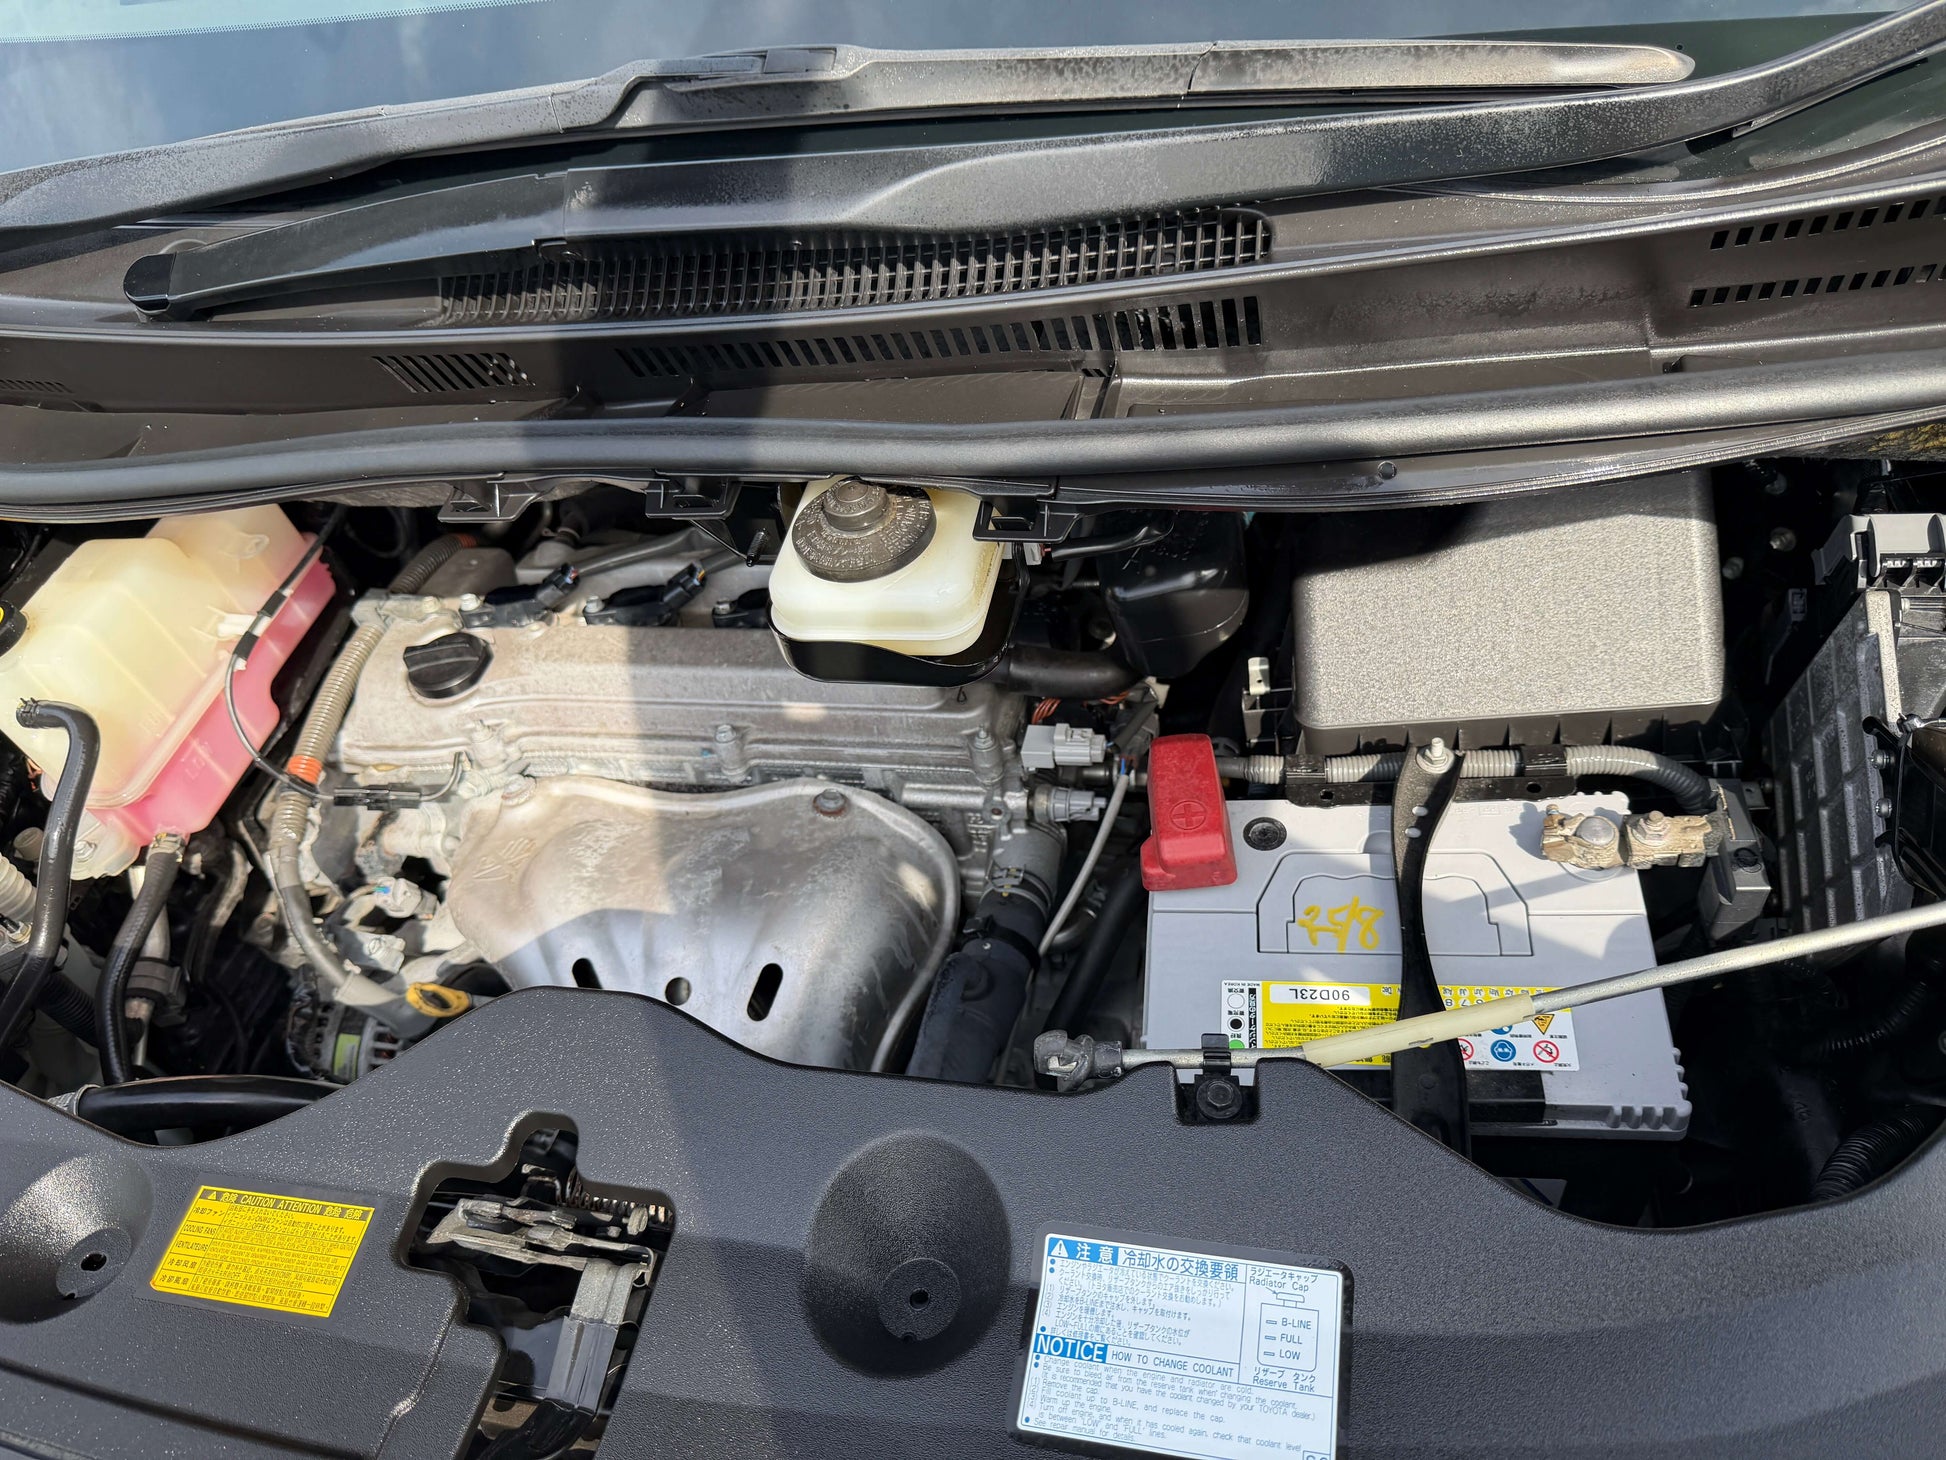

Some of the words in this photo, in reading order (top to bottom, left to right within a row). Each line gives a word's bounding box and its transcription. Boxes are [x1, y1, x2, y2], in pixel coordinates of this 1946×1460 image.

[1289, 988, 1350, 1001] 90D23L
[239, 1195, 275, 1207] CAUTION
[276, 1200, 322, 1214] ATTENTION
[183, 1224, 204, 1233] COOLING
[203, 1227, 216, 1235] FANS
[1122, 1249, 1239, 1281] 冷却水の交換要領
[1250, 1266, 1318, 1283] ラジエータキャップ
[1249, 1275, 1286, 1288] Radiator
[1291, 1281, 1309, 1293] Cap
[1281, 1317, 1311, 1330] B-LINE
[1280, 1333, 1302, 1344] FULL
[1036, 1334, 1104, 1362] NOTICE
[1279, 1349, 1300, 1360] LOW
[1111, 1350, 1131, 1361] HOW
[1136, 1354, 1148, 1364] TO
[1153, 1357, 1188, 1370] CHANGE
[1192, 1362, 1233, 1377] COOLANT
[1074, 1361, 1099, 1371] coolant
[1104, 1365, 1121, 1374] when
[1142, 1371, 1165, 1382] engine
[1170, 1375, 1183, 1384] and
[1188, 1378, 1215, 1388] radiator
[1293, 1372, 1316, 1383] タンク
[1042, 1378, 1067, 1389] Remove
[1071, 1383, 1082, 1391] the
[1084, 1370, 1101, 1379] bleed
[1150, 1381, 1175, 1390] reserve
[1179, 1385, 1194, 1393] tank
[1255, 1396, 1266, 1404] the
[1252, 1376, 1287, 1389] Reserve
[1294, 1381, 1315, 1393] Tank
[1055, 1389, 1081, 1399] coolant
[1143, 1402, 1157, 1411] and
[1161, 1405, 1188, 1418] replace
[1193, 1410, 1205, 1419] the
[1121, 1385, 1133, 1393] you
[1136, 1386, 1152, 1395] have
[1240, 1403, 1254, 1412] your
[1259, 1405, 1287, 1416] TOYOTA
[1098, 1411, 1111, 1420] and
[1255, 1436, 1280, 1448] coolant
